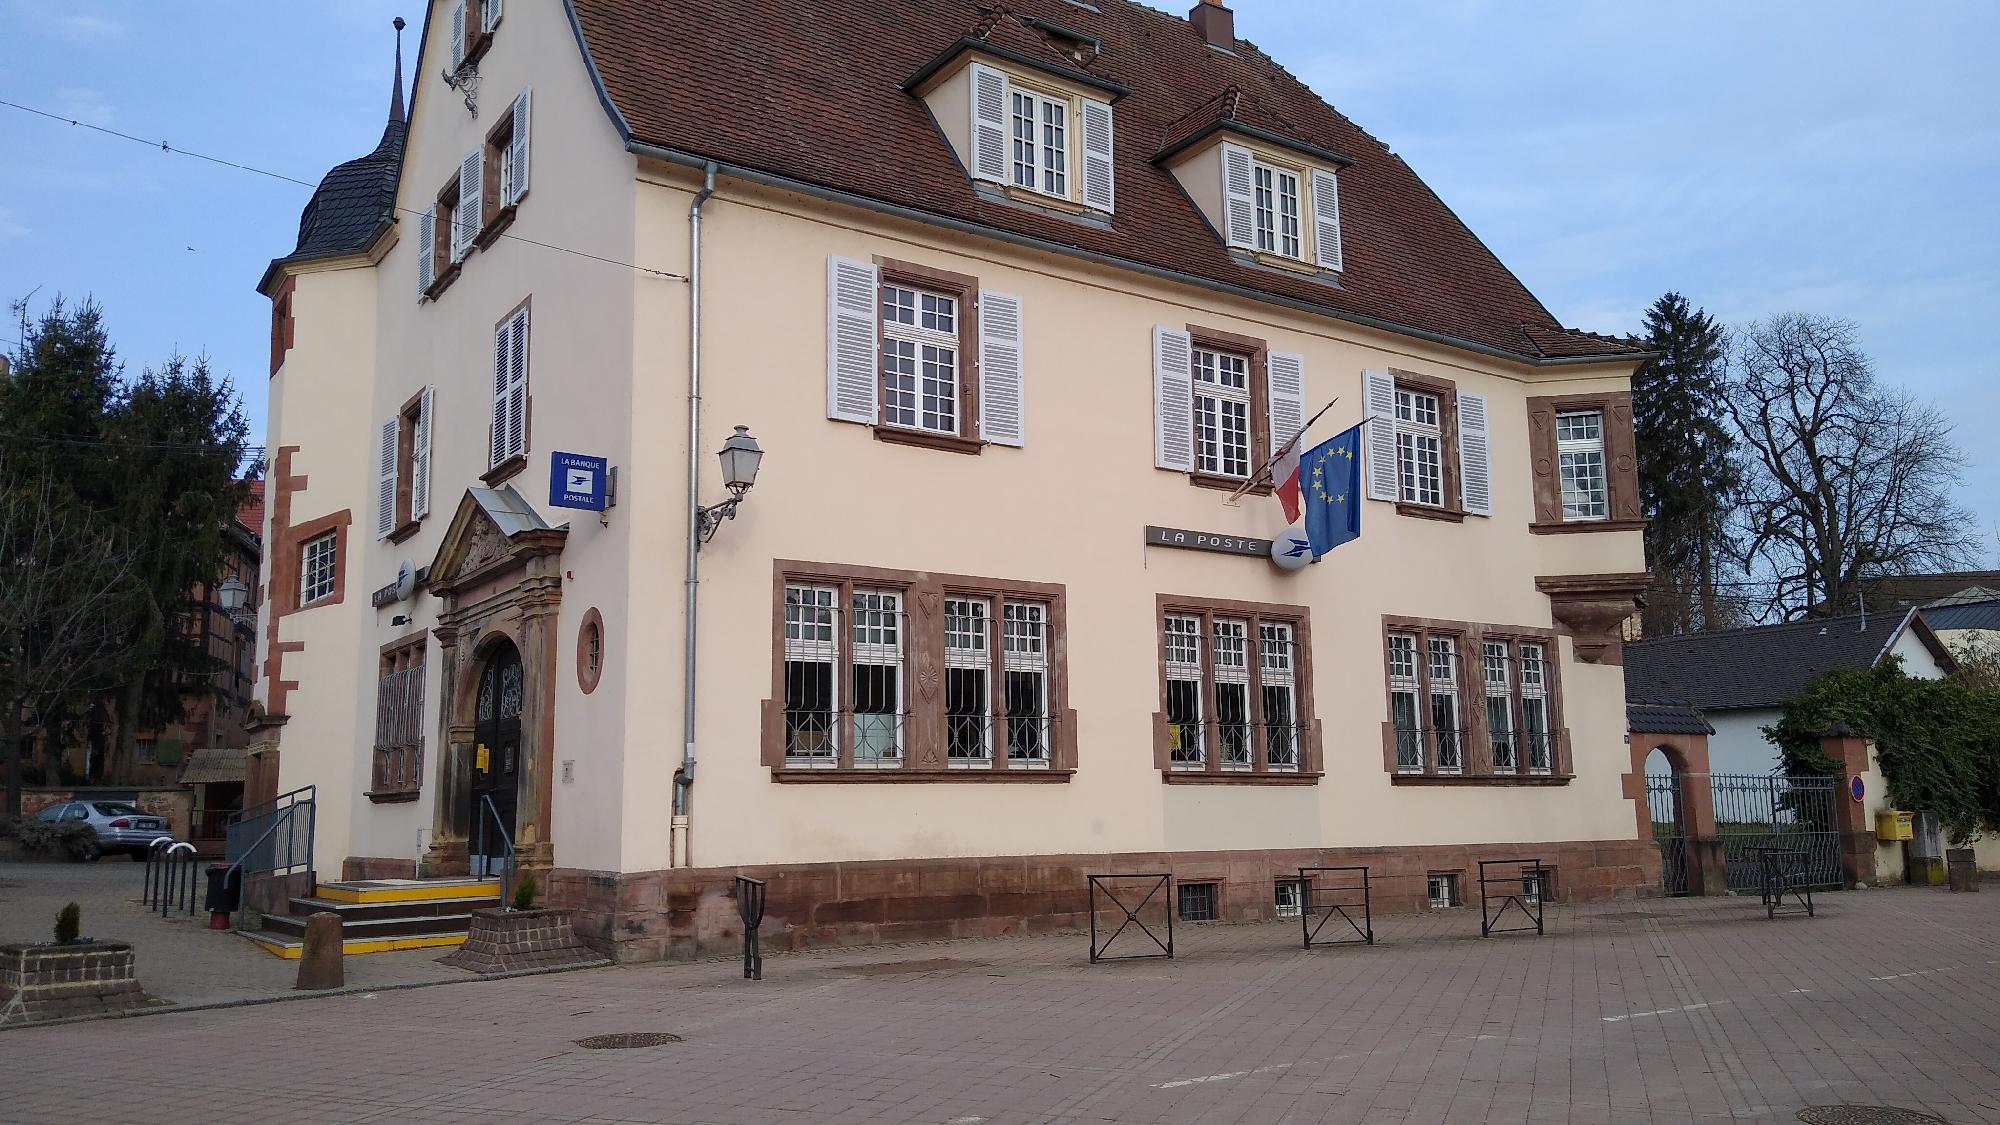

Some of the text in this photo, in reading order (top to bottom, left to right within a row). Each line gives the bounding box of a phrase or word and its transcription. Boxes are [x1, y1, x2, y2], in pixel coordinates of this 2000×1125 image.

[562, 458, 601, 470] LA BANQUE
[563, 493, 595, 504] POSTALE
[1161, 530, 1257, 551] LA POSTE
